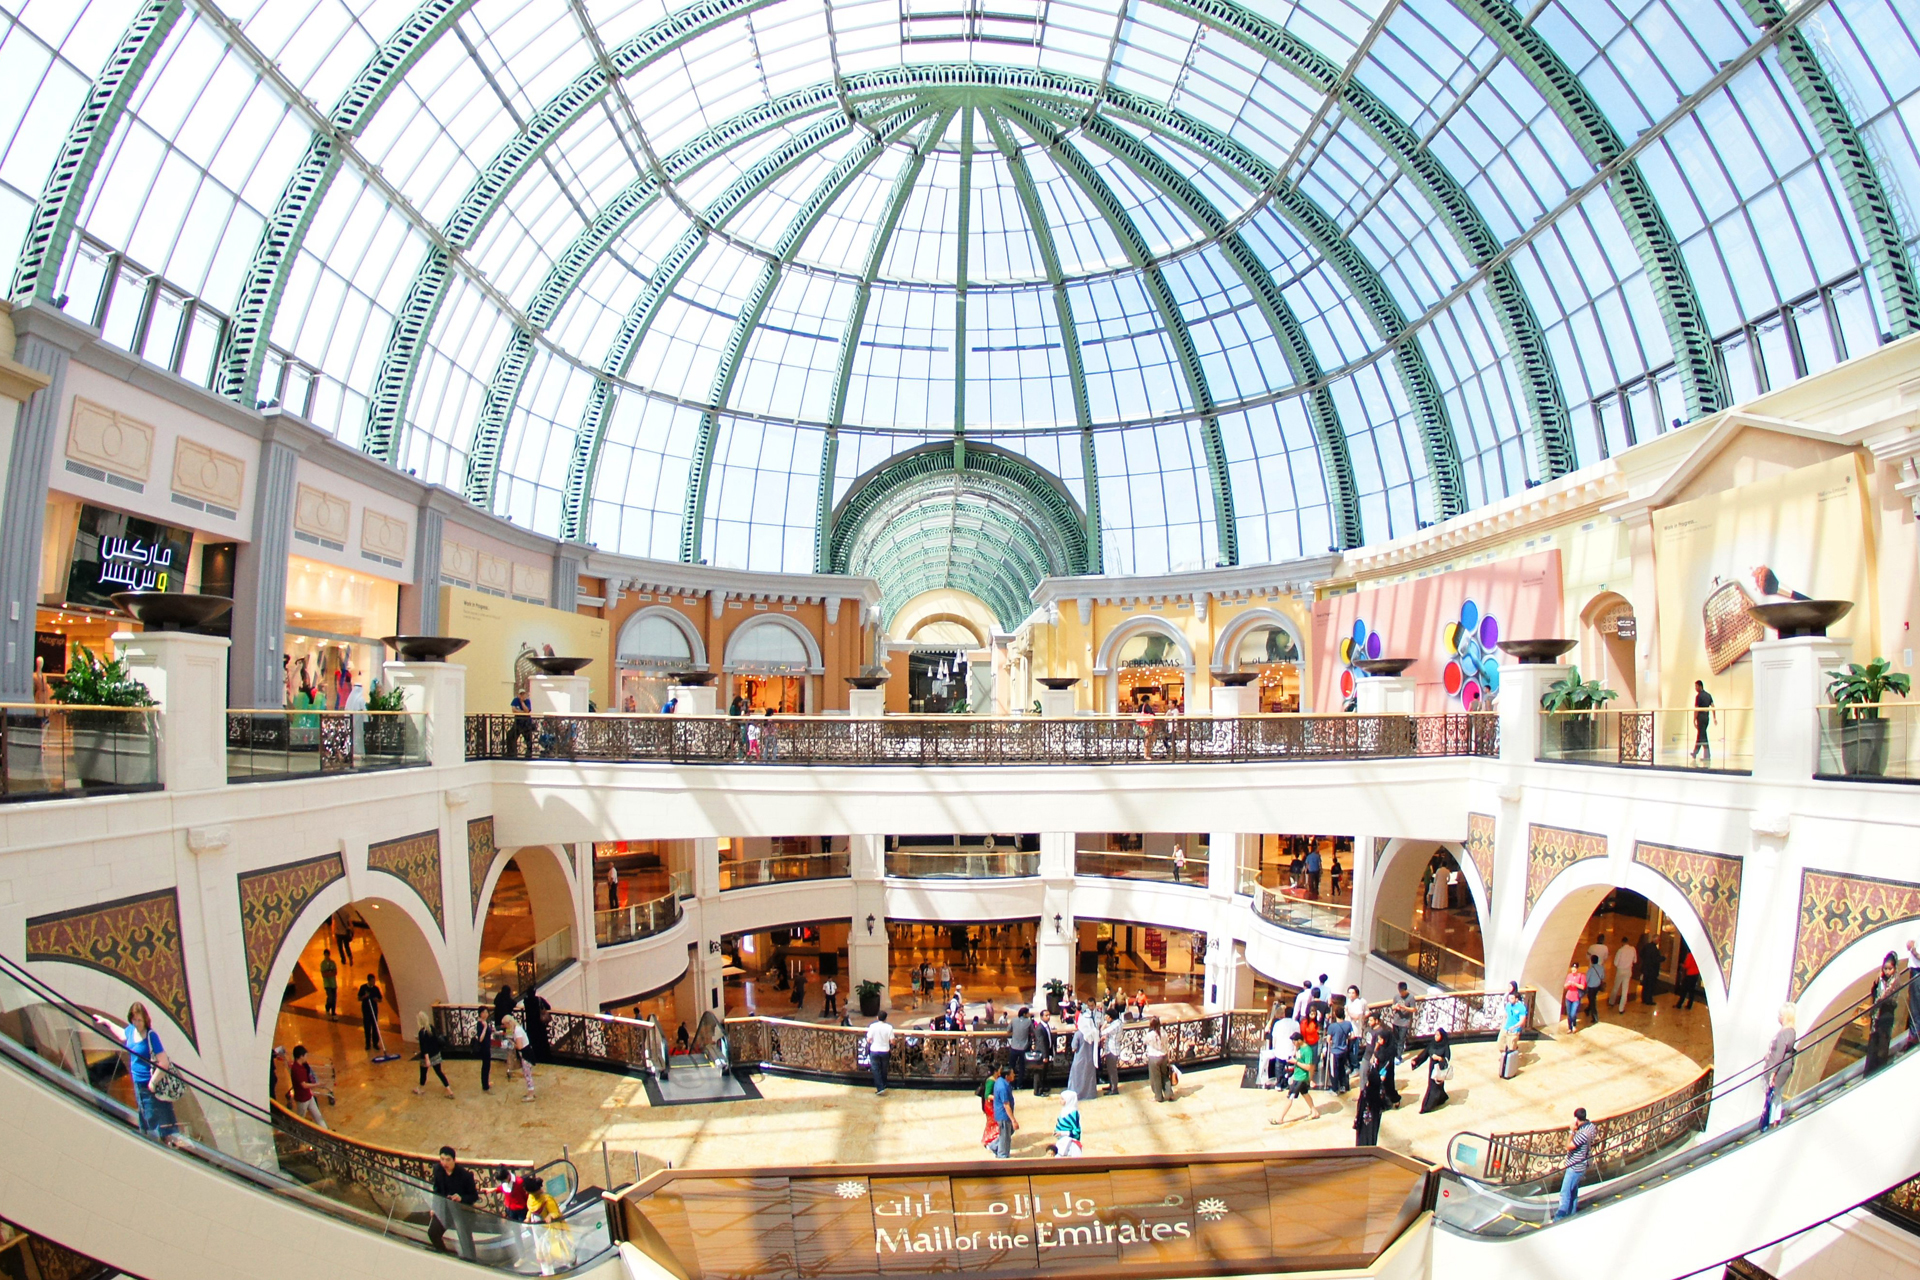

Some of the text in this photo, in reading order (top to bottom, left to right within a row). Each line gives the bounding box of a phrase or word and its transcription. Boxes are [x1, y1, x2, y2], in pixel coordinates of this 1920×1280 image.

[101, 535, 171, 566] ماركس
[1121, 658, 1180, 668] DEBENHAMS
[955, 1230, 981, 1250] of
[987, 1231, 1030, 1250] the
[1036, 1219, 1191, 1248] Emirates
